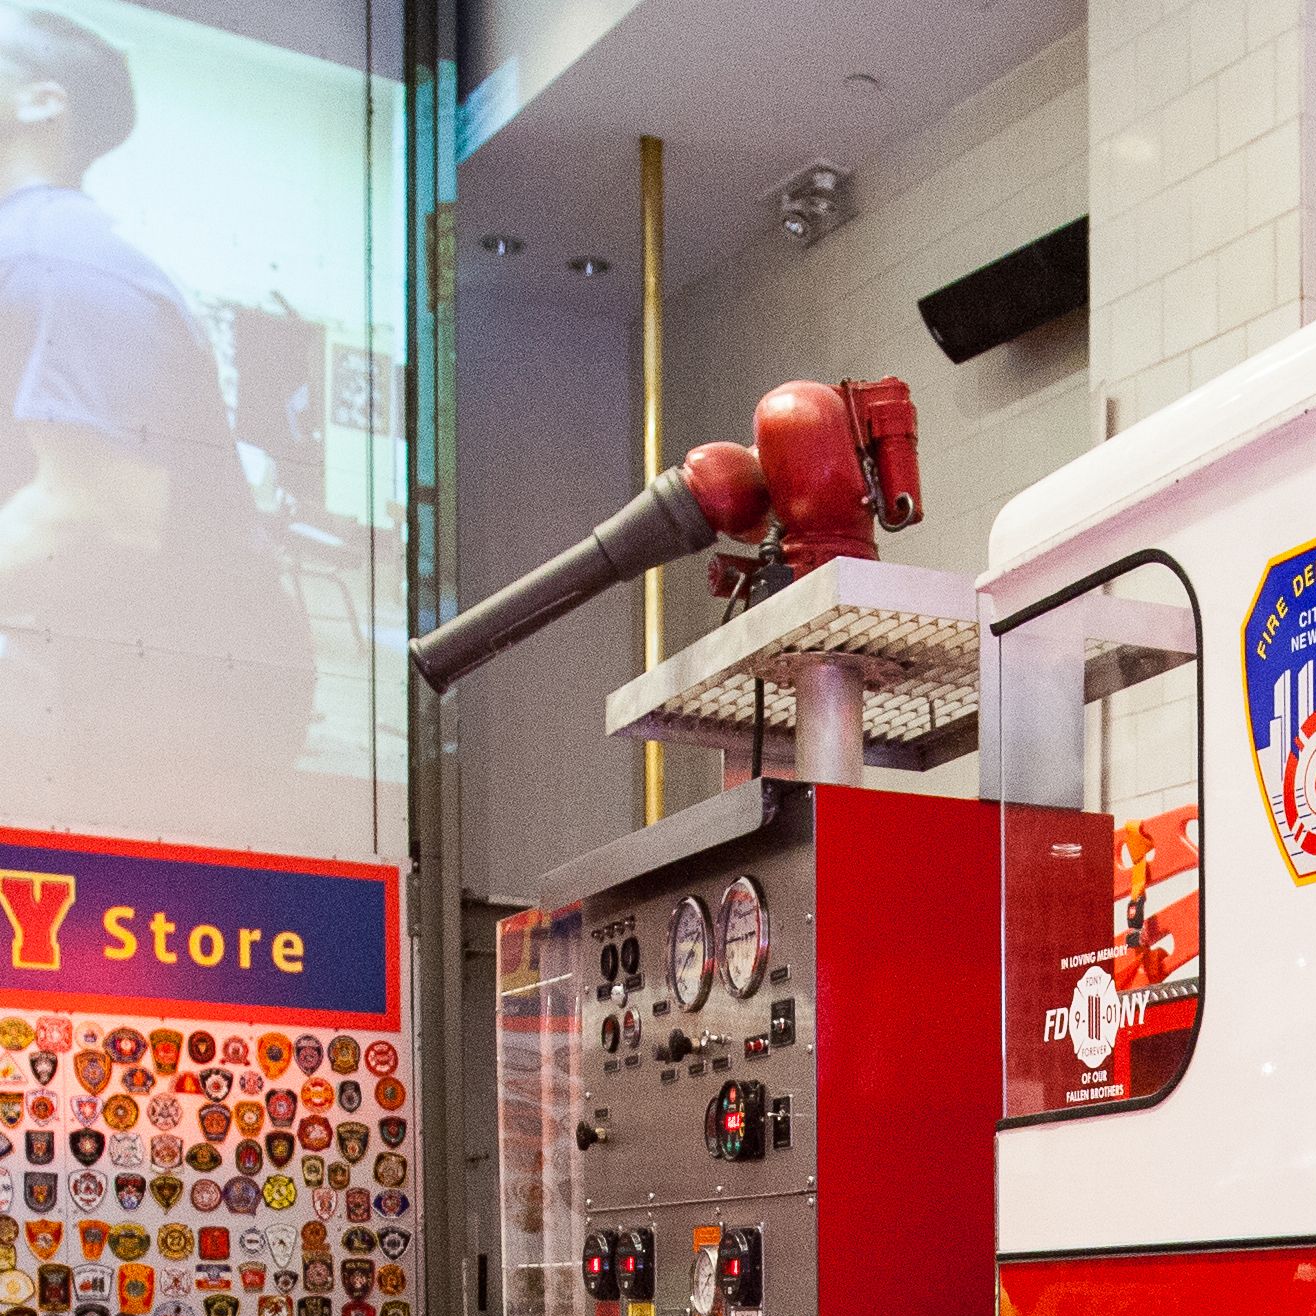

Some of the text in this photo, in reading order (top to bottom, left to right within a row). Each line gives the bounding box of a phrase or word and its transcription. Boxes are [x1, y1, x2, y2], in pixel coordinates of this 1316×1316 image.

[1256, 595, 1289, 660] FIRE
[103, 905, 304, 974] Store
[1061, 944, 1128, 970] IN LOVING MEMORY
[1085, 975, 1102, 987] FDNY
[1043, 1006, 1069, 1042] FD
[1120, 989, 1150, 1029] NY
[1081, 1045, 1107, 1058] FOREVER
[1081, 1069, 1108, 1085] OF OUR
[1066, 1084, 1124, 1103] FALLEN BROTHERS
